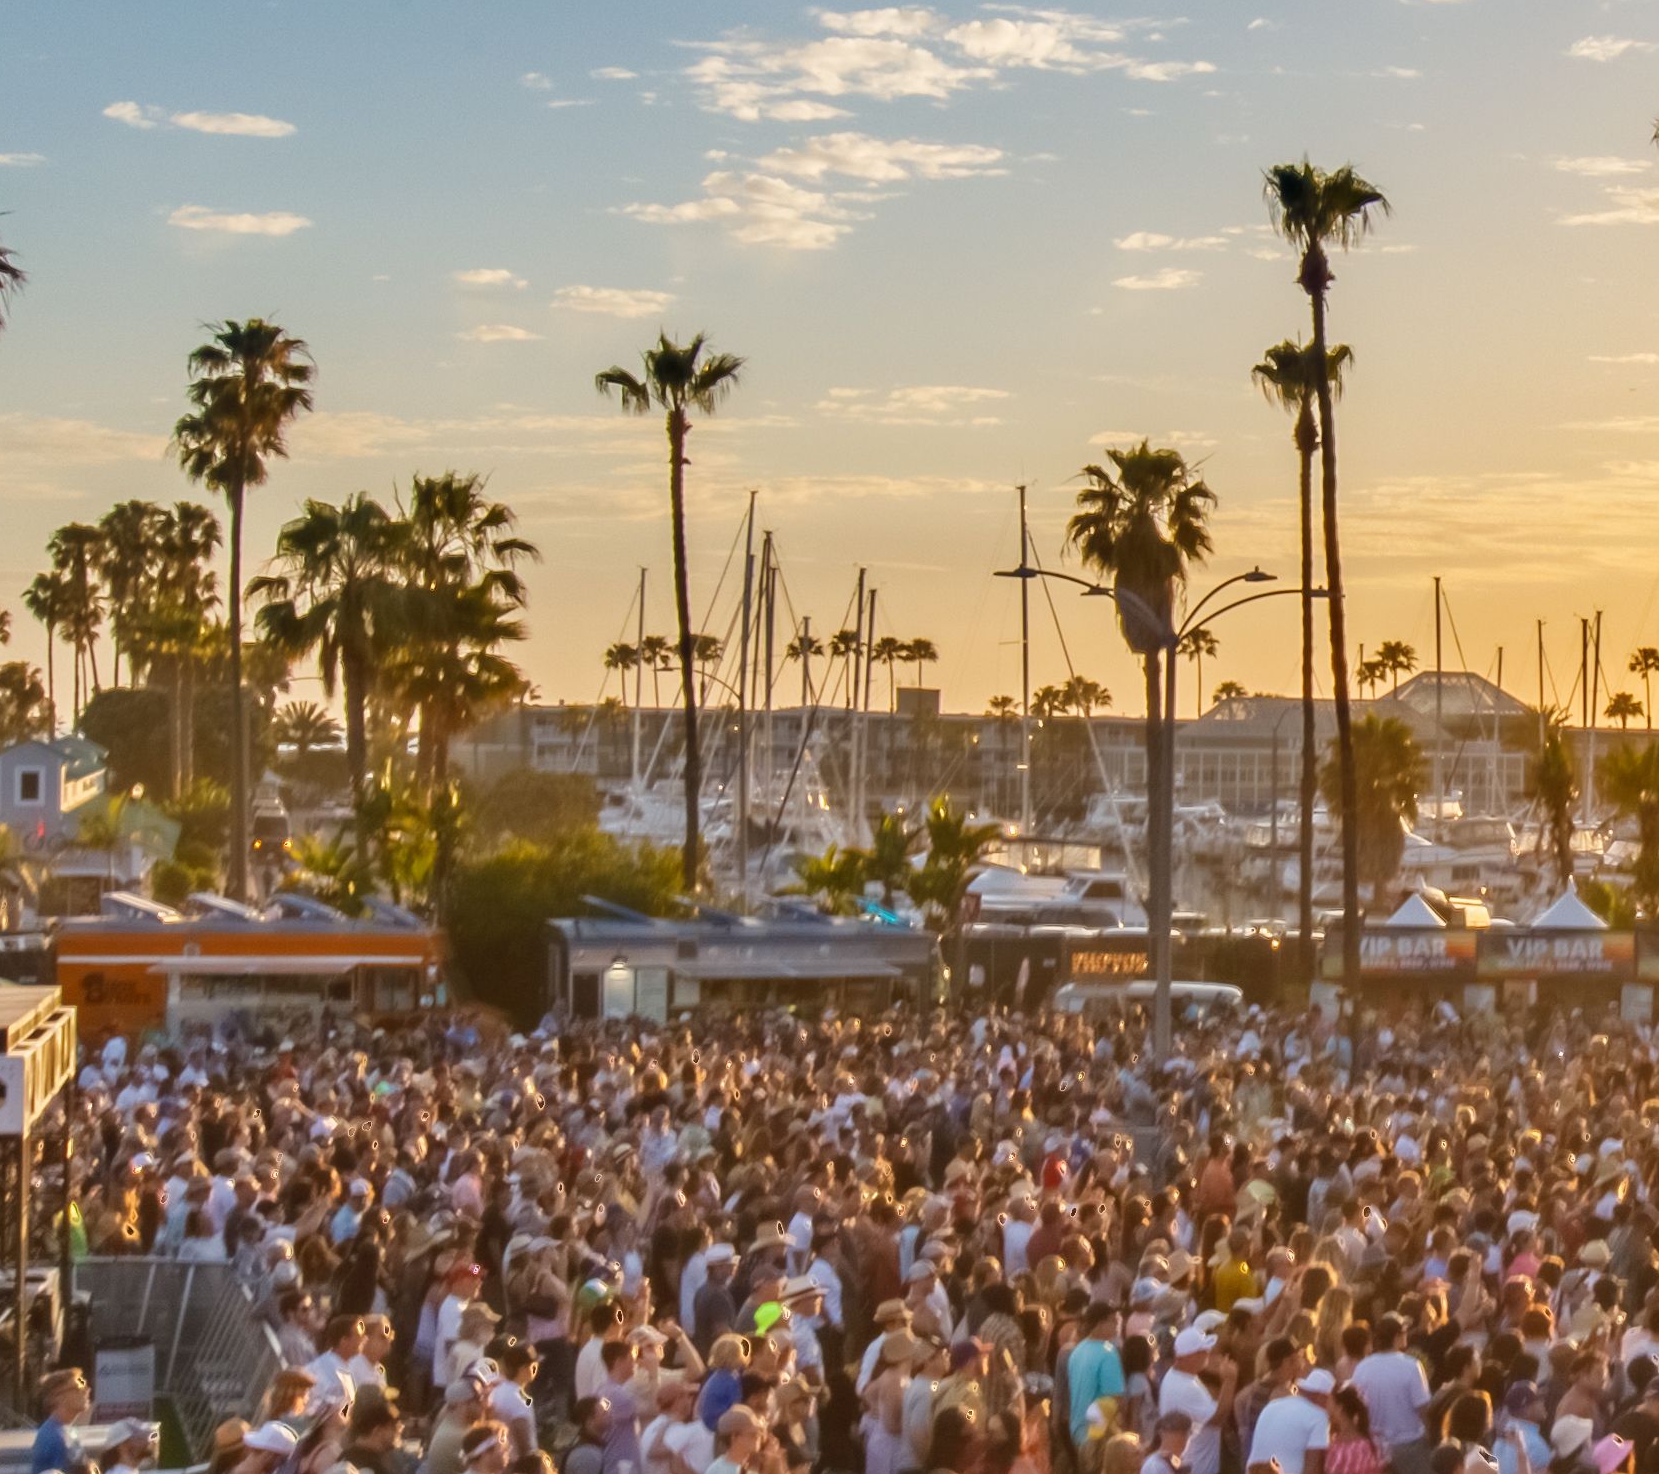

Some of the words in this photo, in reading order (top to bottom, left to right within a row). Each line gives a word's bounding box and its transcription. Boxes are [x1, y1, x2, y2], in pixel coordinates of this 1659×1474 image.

[1397, 936, 1448, 958] BAR
[1506, 936, 1547, 959] VIP
[1553, 936, 1605, 959] BAR
